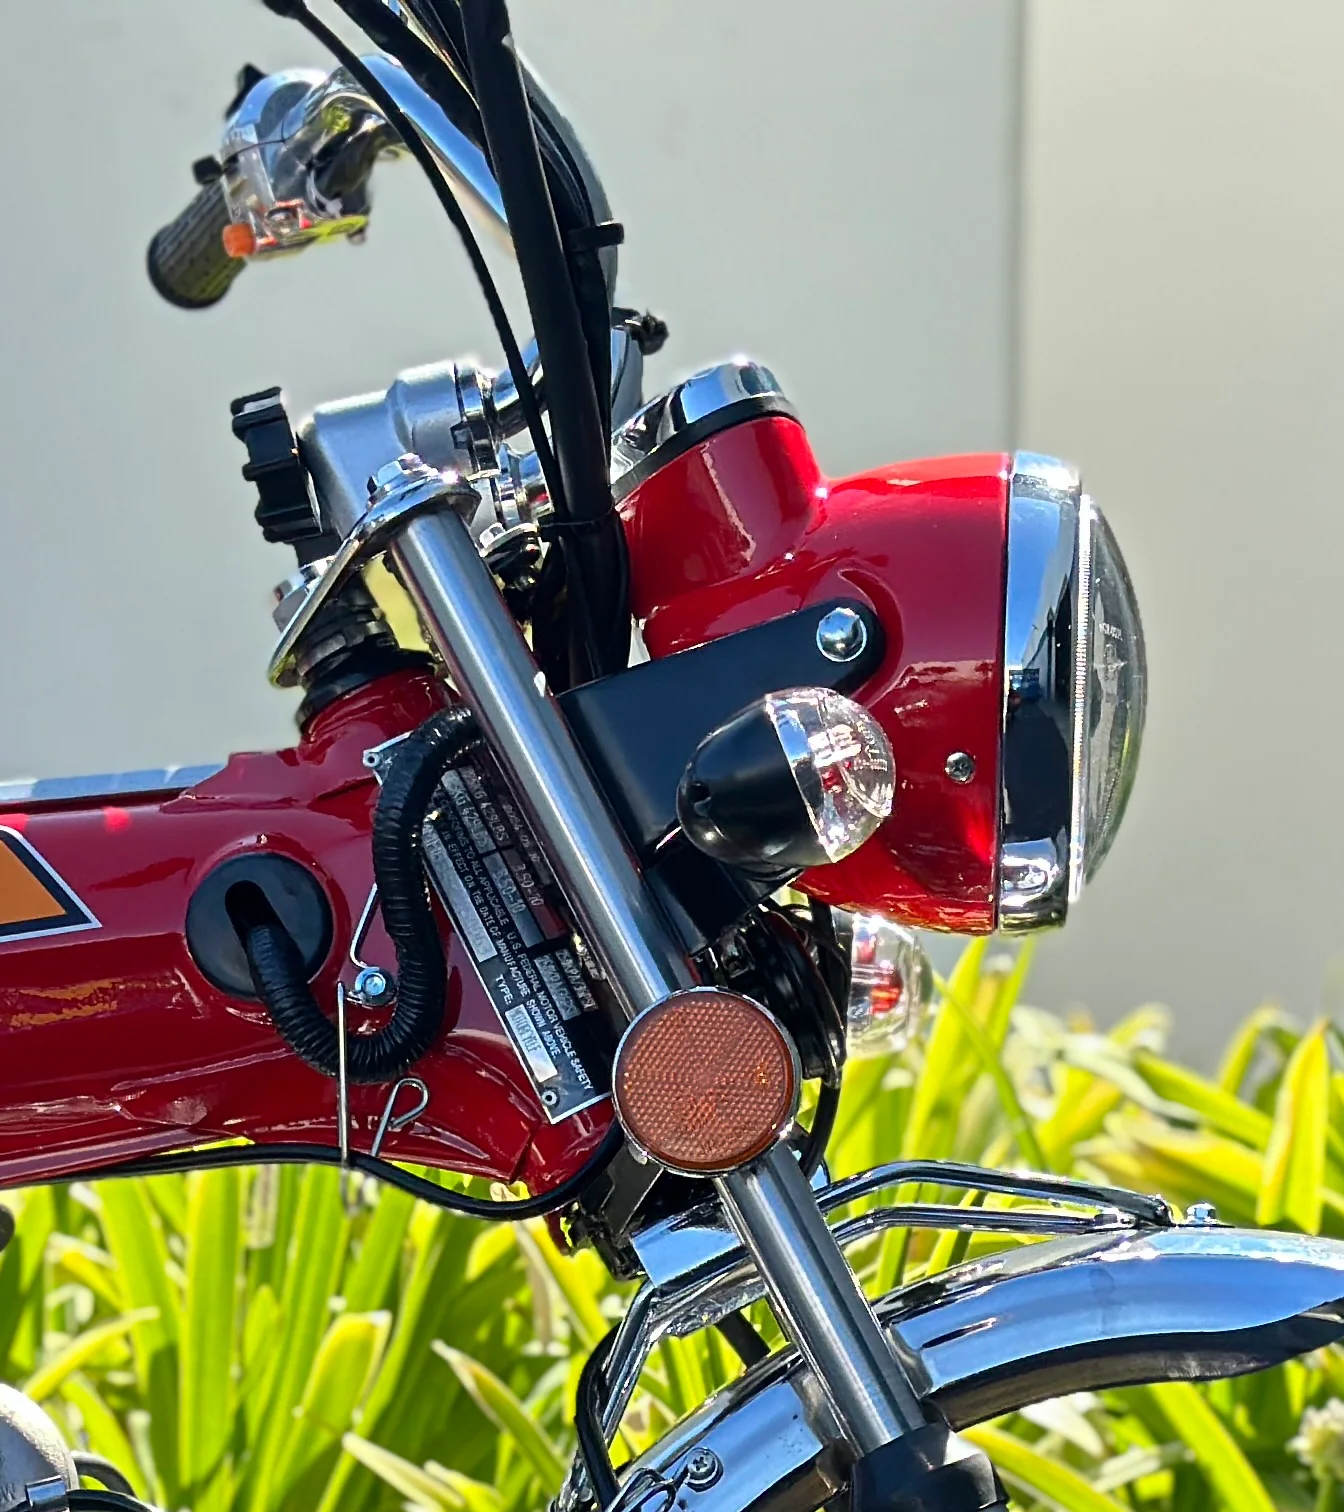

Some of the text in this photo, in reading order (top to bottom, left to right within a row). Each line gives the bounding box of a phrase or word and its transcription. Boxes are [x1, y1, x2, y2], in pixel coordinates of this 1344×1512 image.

[463, 845, 476, 860] TO
[469, 858, 483, 875] ALL
[477, 874, 509, 926] APPLICABLE
[447, 841, 469, 874] EFFECT
[471, 889, 485, 905] THE
[478, 905, 495, 927] DATE
[488, 924, 501, 938] OF
[495, 937, 531, 997] MANUFACTURE
[525, 997, 547, 1028] SHOWN
[493, 973, 515, 1005] TYPE:
[516, 952, 542, 992] FEDERAL
[535, 990, 558, 1023] MOTOR
[552, 1022, 576, 1059] VEHICLE
[569, 1056, 593, 1092] SAFETY
